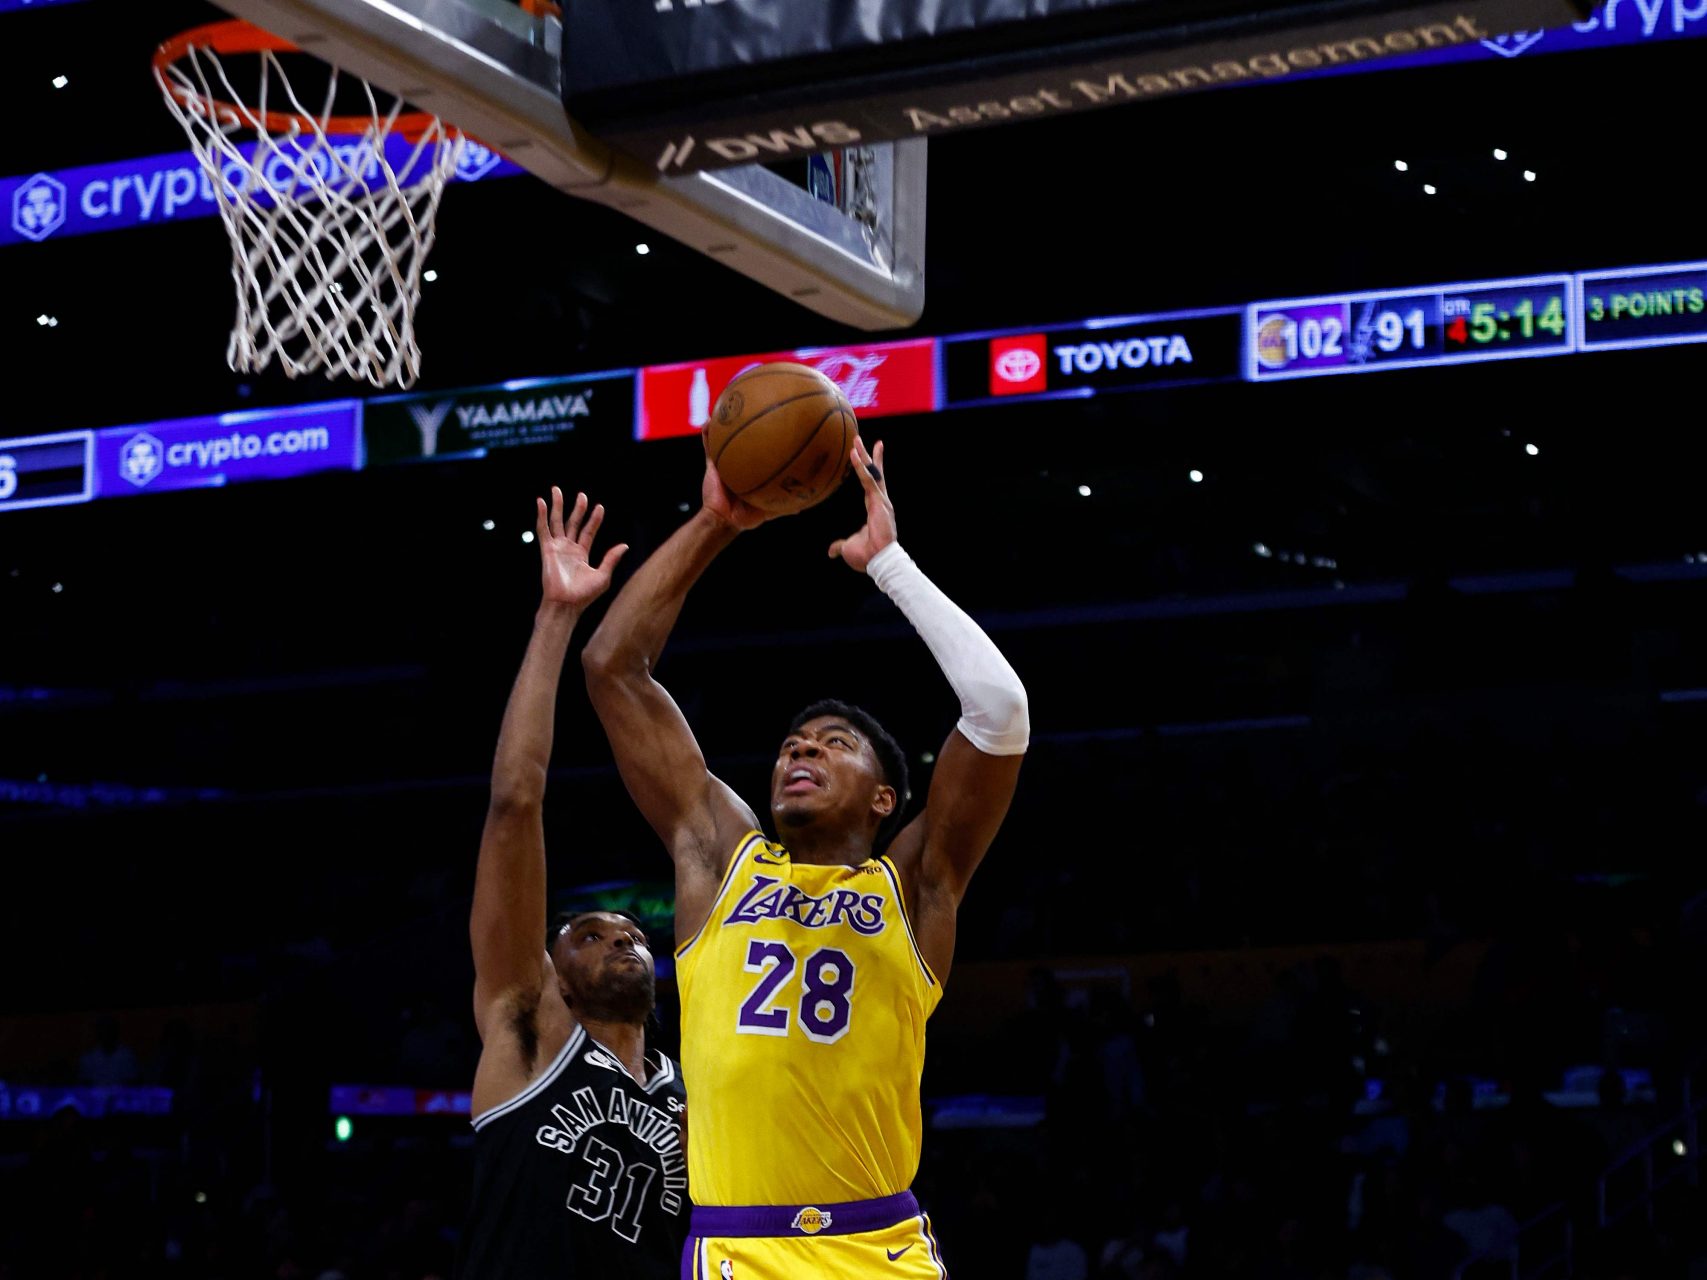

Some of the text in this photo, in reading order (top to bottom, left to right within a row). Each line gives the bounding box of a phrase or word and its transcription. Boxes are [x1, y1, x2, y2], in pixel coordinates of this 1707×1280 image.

[904, 88, 1067, 130] Asset
[1072, 14, 1484, 100] Management
[1470, 297, 1565, 342] 5:14
[1589, 288, 1704, 321] 3 POINTS
[1281, 317, 1343, 360] 102
[1376, 309, 1425, 351] 91
[1447, 316, 1468, 343] 4
[1054, 334, 1193, 375] TOYOTA
[166, 427, 329, 467] crypto.com
[722, 875, 886, 936] LAKERS
[736, 936, 855, 1045] 28
[536, 1086, 687, 1216] SAN ANTONIO
[566, 1136, 657, 1244] 31
